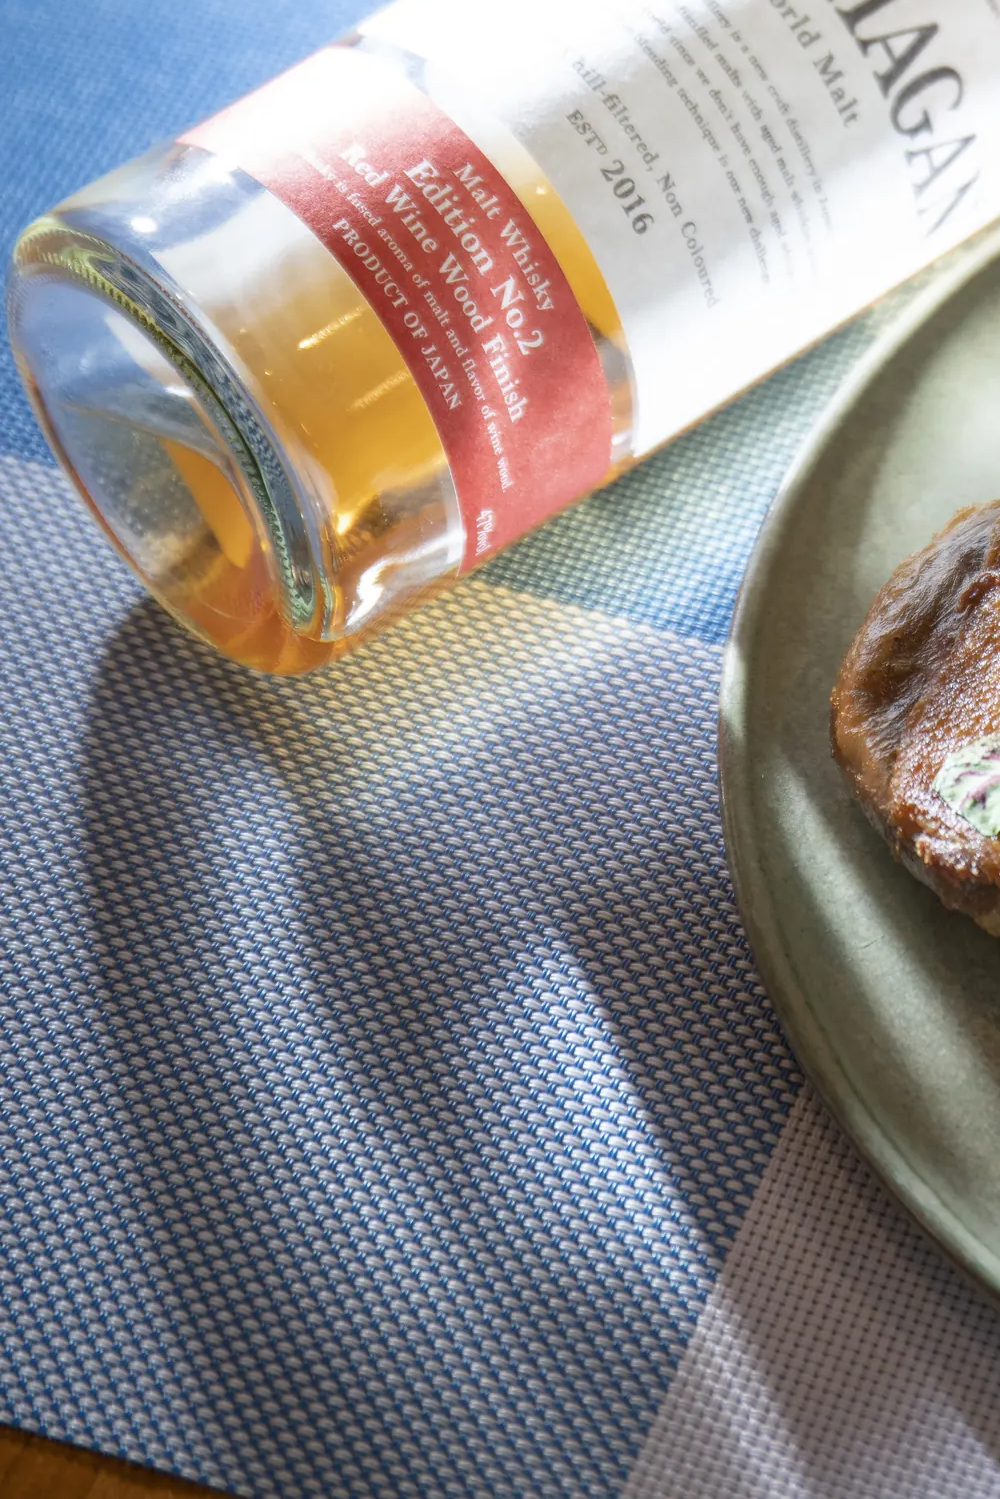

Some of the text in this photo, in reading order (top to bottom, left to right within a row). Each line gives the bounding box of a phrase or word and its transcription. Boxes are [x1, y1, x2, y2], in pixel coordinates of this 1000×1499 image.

[669, 35, 696, 67] since
[695, 68, 711, 86] we
[708, 89, 733, 121] don't
[729, 121, 752, 156] have
[748, 158, 775, 208] enough
[769, 210, 786, 236] aged
[677, 87, 721, 152] technique
[717, 154, 729, 168] is
[725, 170, 742, 194] our
[738, 197, 754, 224] new
[715, 53, 743, 88] malts
[741, 90, 764, 122] with
[760, 124, 783, 154] aged
[776, 156, 795, 187] malt
[730, 30, 743, 43] is
[748, 55, 769, 81] new
[767, 84, 791, 116] craft
[786, 118, 818, 177] distillery
[812, 52, 859, 127] Malt
[403, 157, 545, 356] Edition No.2
[452, 161, 555, 311] Malt Whisky
[566, 54, 717, 305] hill-filtered, Non Coloured
[599, 159, 655, 235] 2016
[331, 217, 462, 410] PRODUCT OF JAPAN
[334, 179, 514, 493] is fused aroma of malt and flavor of wine wood.
[338, 142, 528, 423] Red Wine Wood Finish
